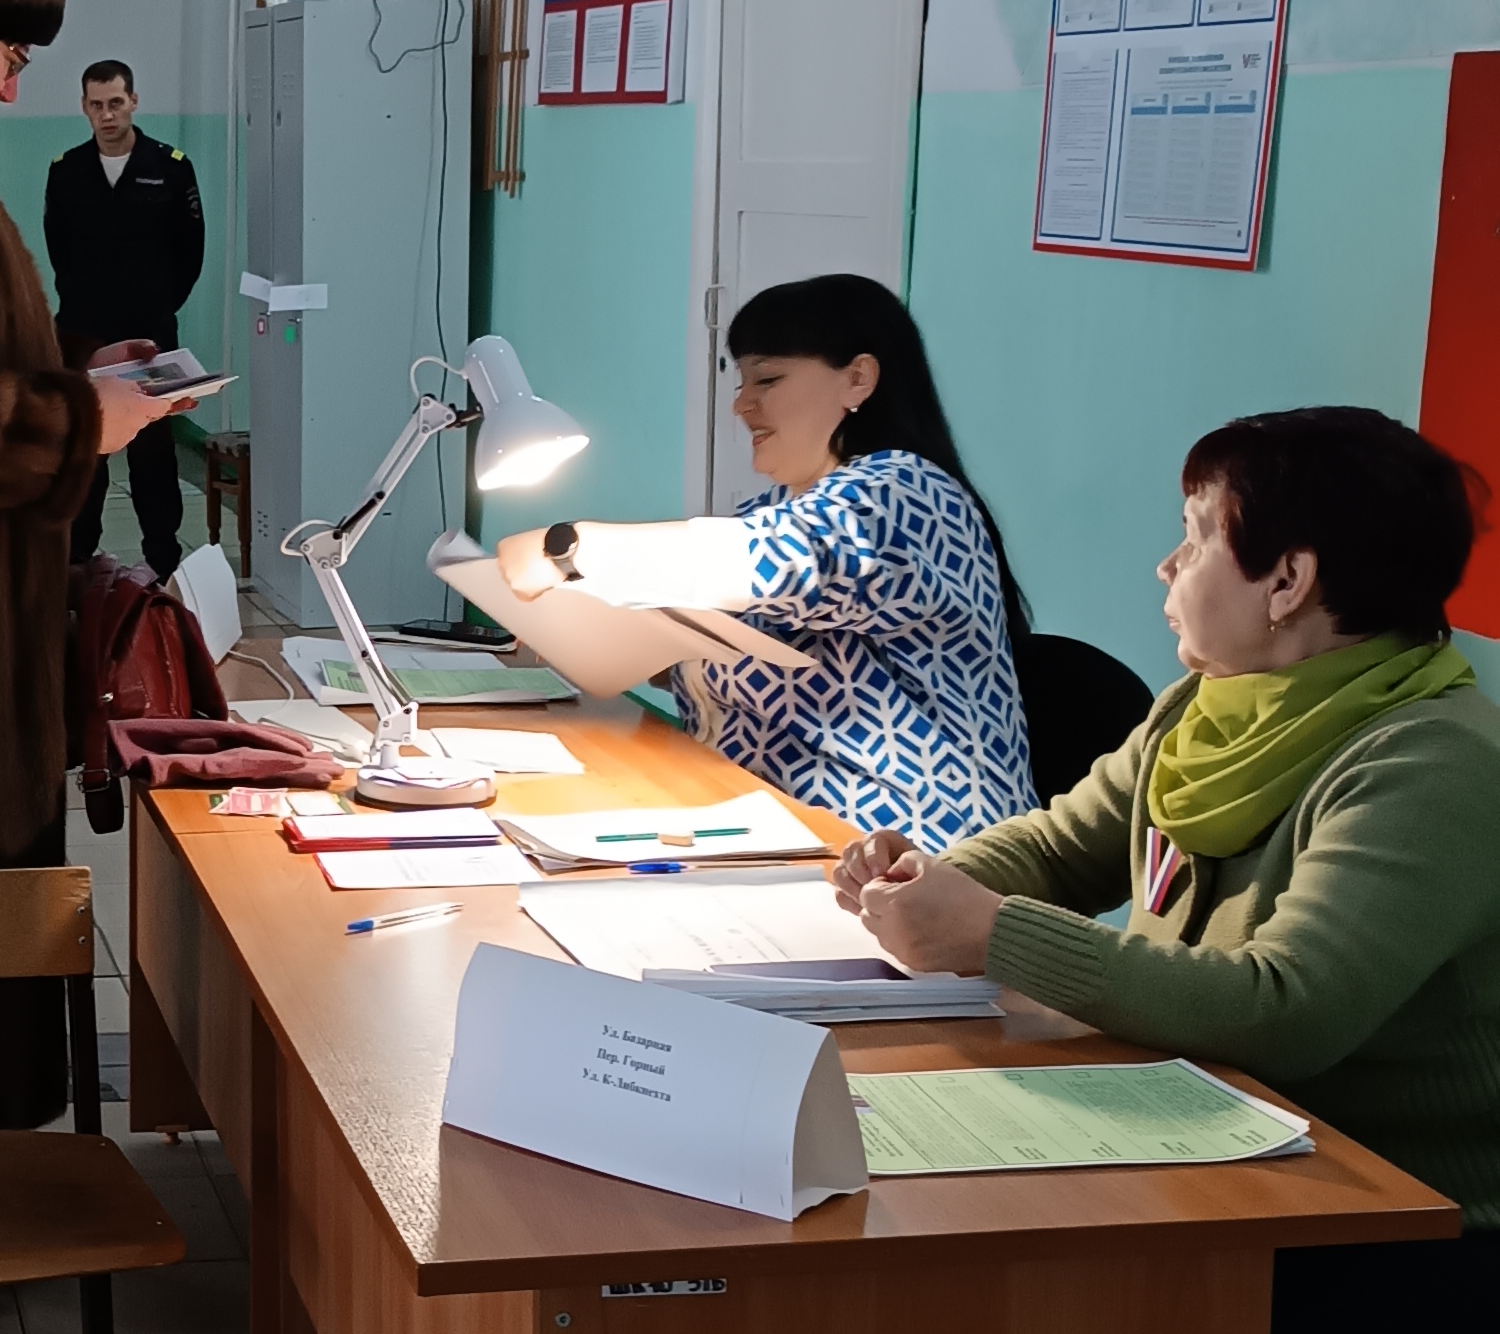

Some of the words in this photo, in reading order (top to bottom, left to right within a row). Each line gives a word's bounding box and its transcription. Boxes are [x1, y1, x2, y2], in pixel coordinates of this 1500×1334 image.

[602, 1024, 620, 1039] Ул.
[622, 1030, 672, 1052] Базарная
[582, 1067, 600, 1082] Ул.
[596, 1047, 620, 1065] Пер.
[622, 1055, 666, 1076] Горный
